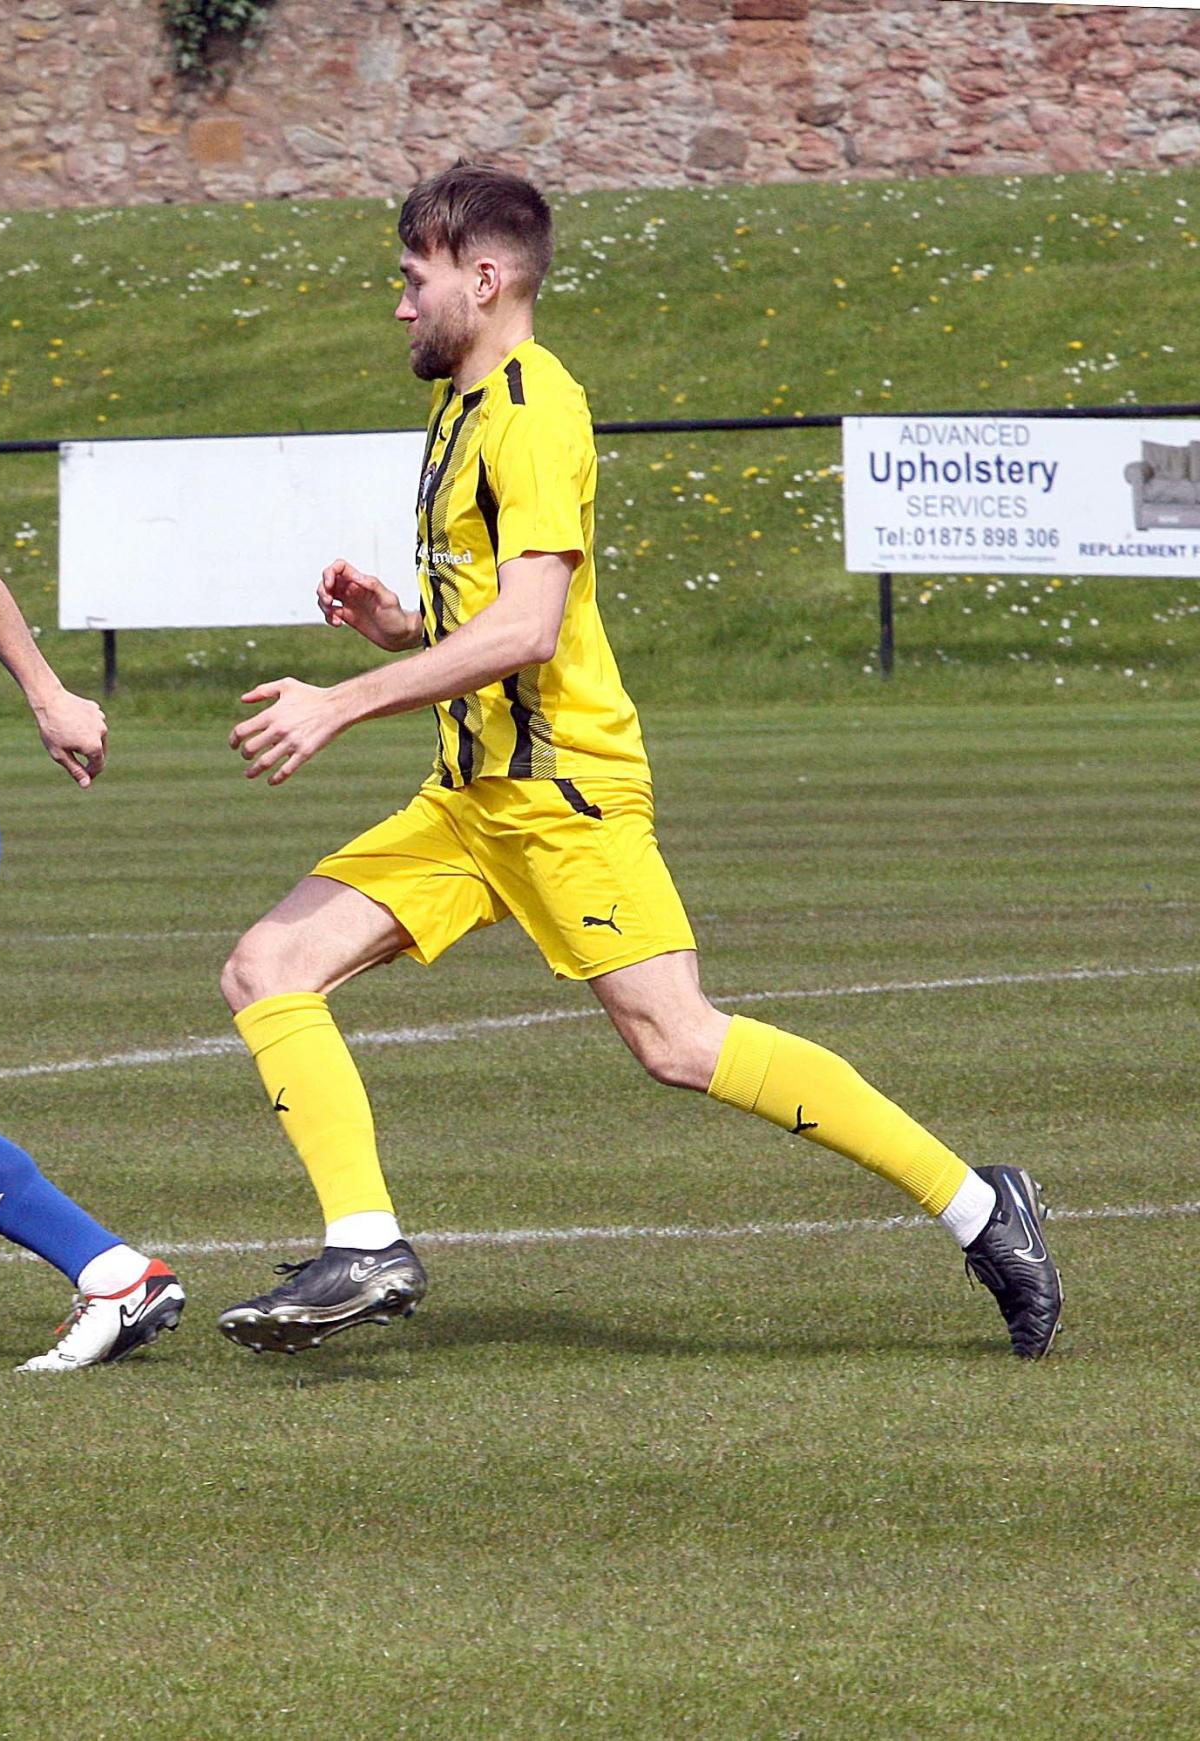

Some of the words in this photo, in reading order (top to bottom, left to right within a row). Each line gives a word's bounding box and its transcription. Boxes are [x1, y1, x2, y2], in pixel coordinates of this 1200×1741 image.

[899, 423, 1030, 447] ADVANCED
[869, 451, 1059, 493] Upholstery
[906, 494, 1028, 518] SERVICES
[875, 526, 976, 547] Tel:01875
[983, 527, 1018, 548] 898
[1025, 528, 1060, 548] 306
[1078, 542, 1186, 557] REPLACEMENT
